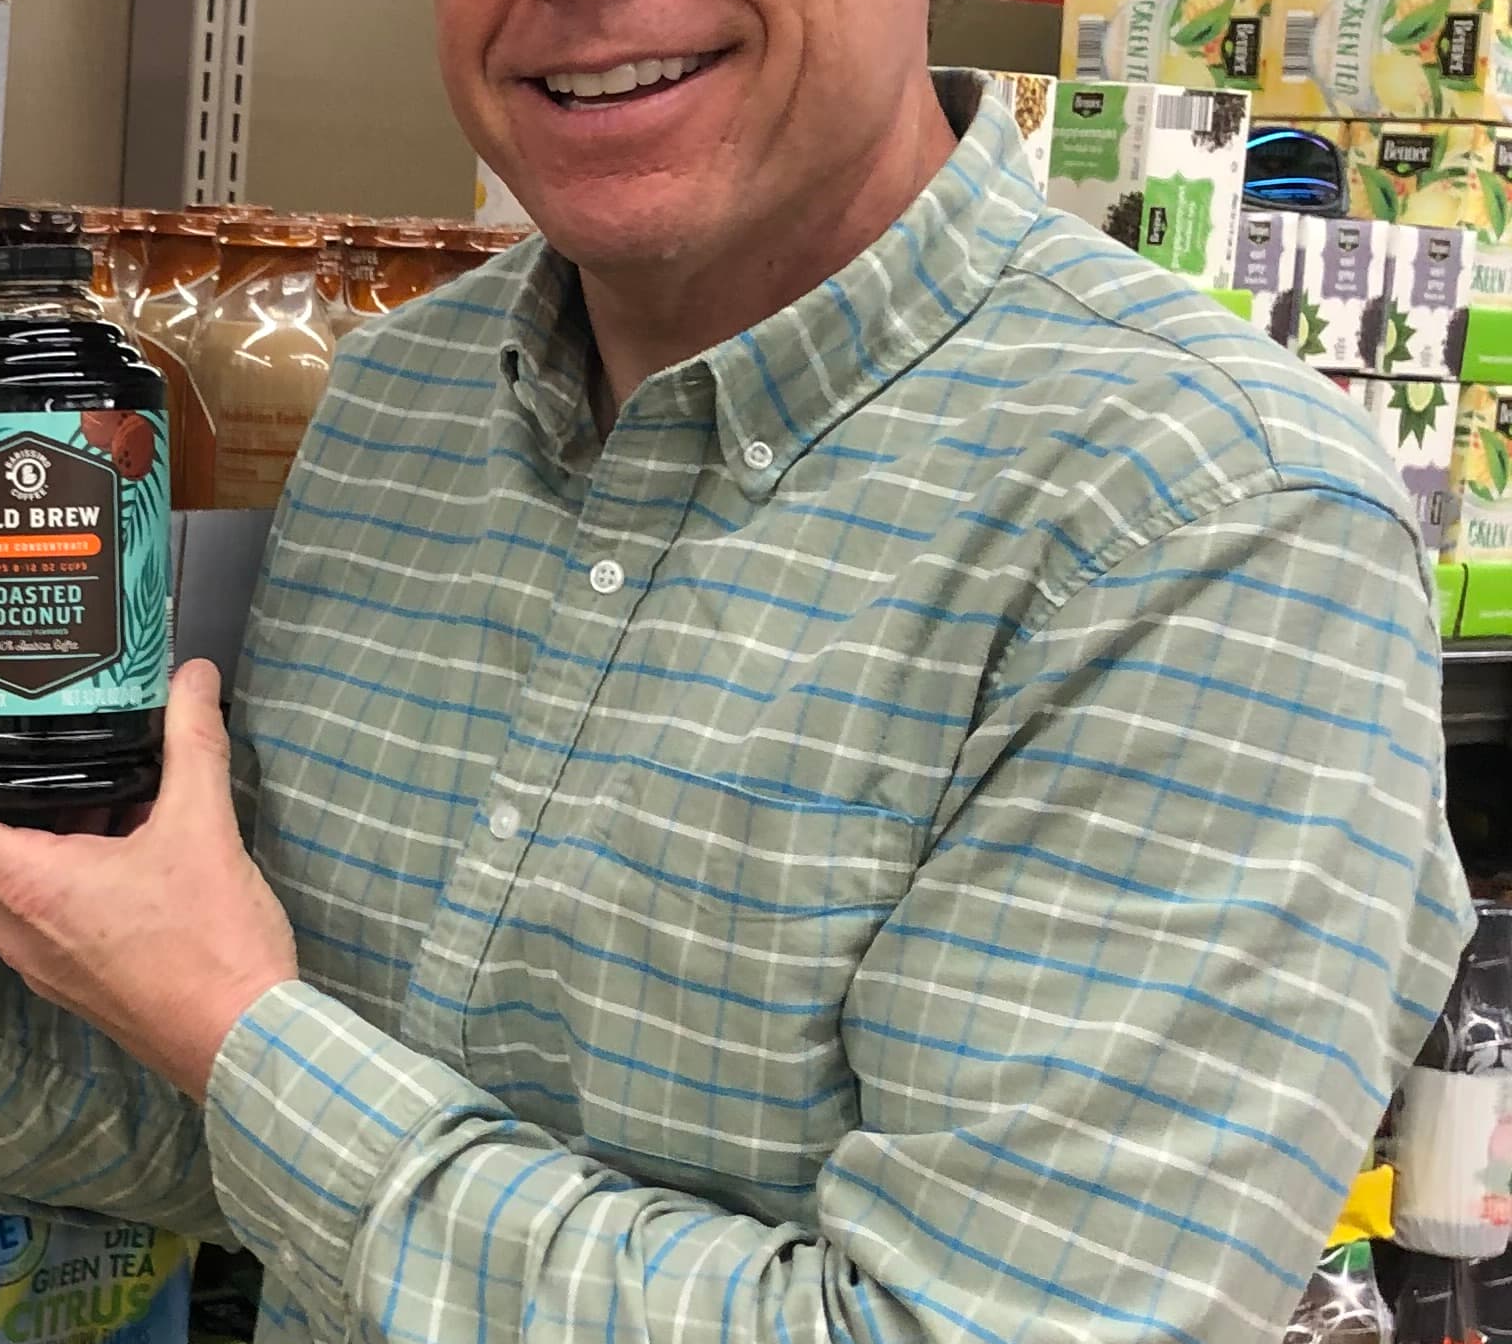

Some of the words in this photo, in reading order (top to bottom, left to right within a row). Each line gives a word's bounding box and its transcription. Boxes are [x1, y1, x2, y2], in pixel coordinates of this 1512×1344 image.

[1129, 0, 1156, 47] GREEN
[1336, 51, 1359, 96] TEA
[1384, 139, 1431, 161] Benner
[30, 507, 101, 529] BREW
[105, 1227, 157, 1250] DIET
[31, 1254, 101, 1294] GREEN
[109, 1254, 156, 1279] TEA
[4, 1283, 152, 1344] CITRUS
